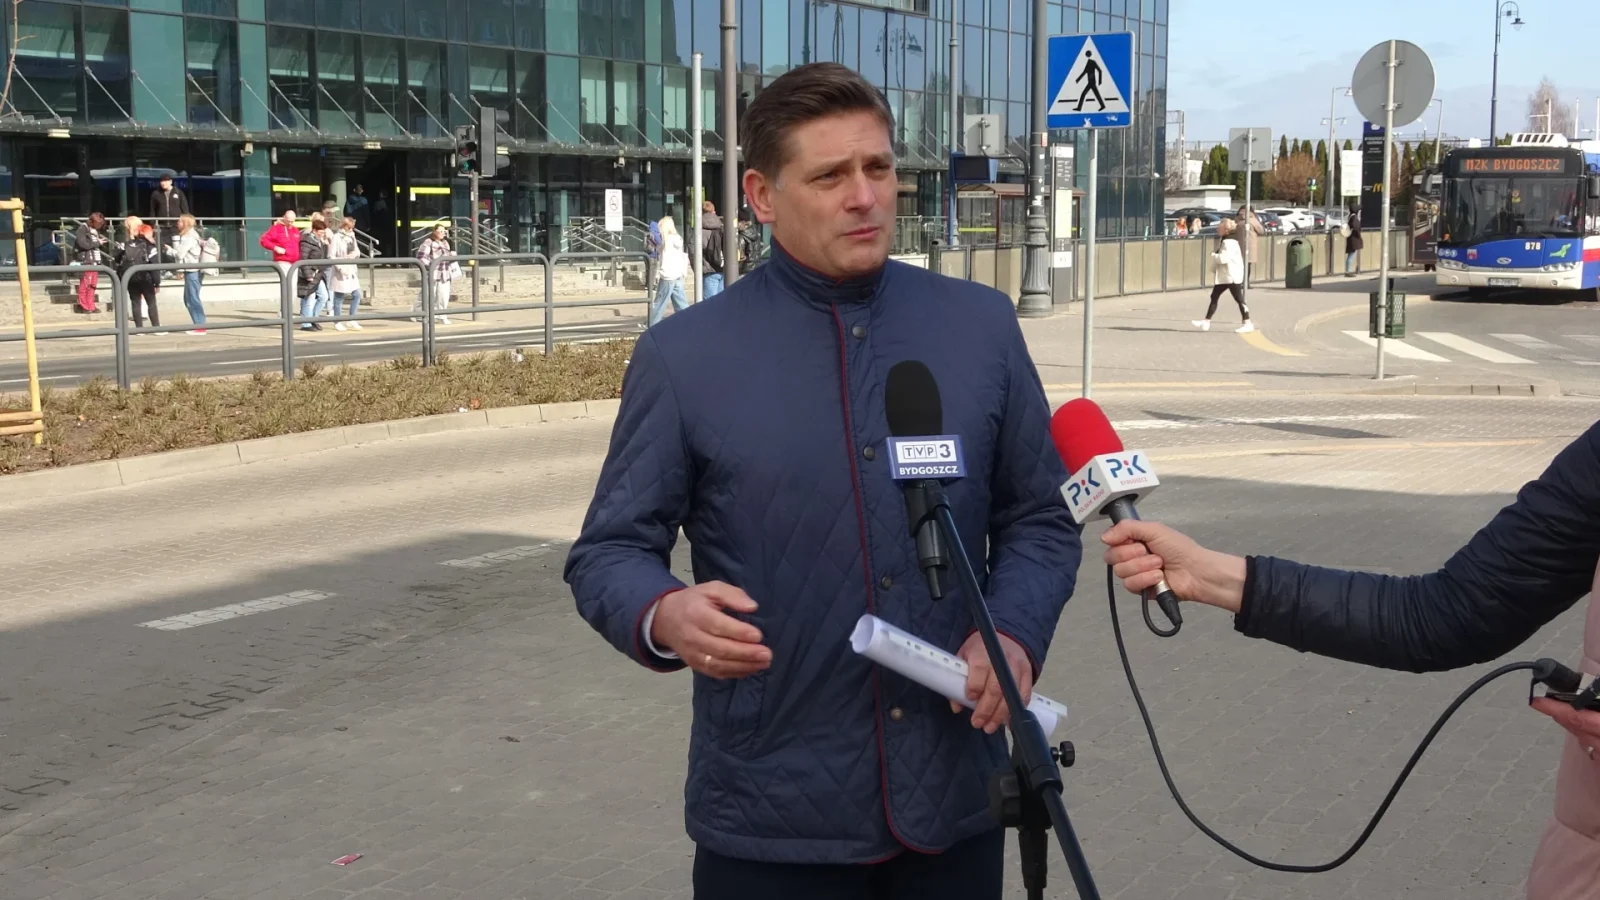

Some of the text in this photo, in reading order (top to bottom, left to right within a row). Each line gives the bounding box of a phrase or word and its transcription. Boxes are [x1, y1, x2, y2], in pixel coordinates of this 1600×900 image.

[1465, 158, 1560, 170] MZK BYDGOSZCZ
[1525, 242, 1541, 250] 878
[903, 444, 951, 458] TVP 3
[899, 465, 959, 475] BYDGOSZCZ
